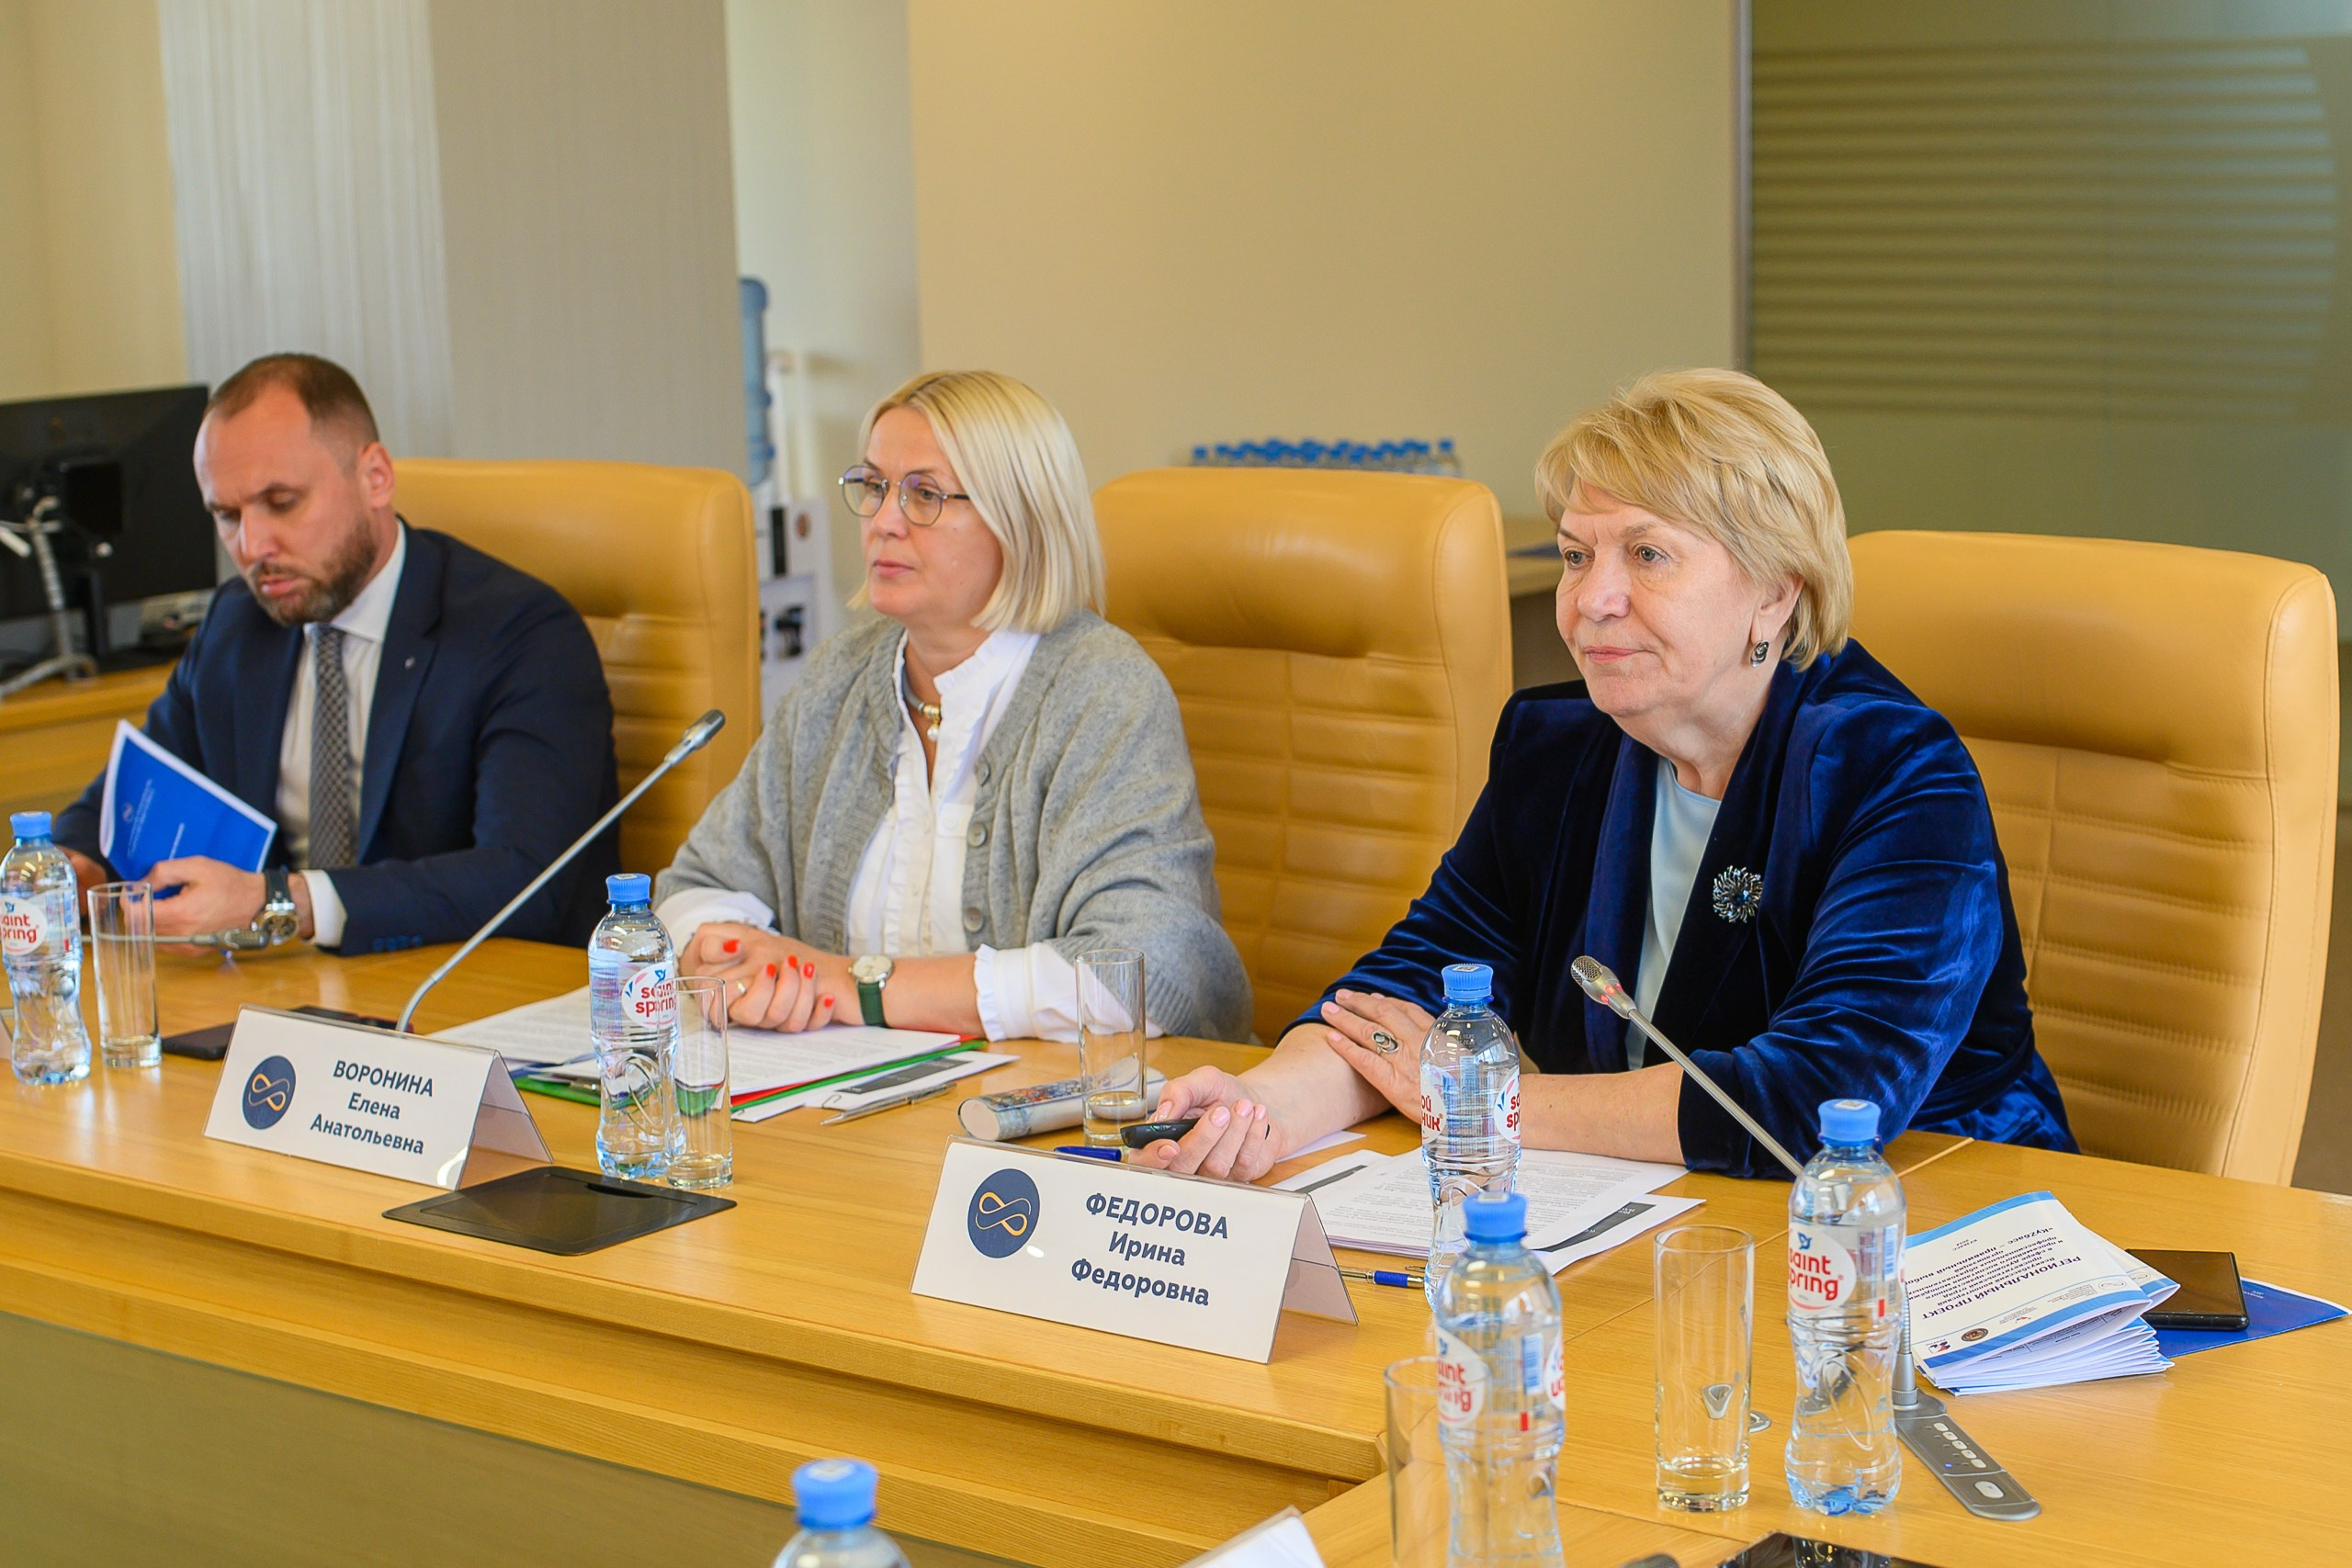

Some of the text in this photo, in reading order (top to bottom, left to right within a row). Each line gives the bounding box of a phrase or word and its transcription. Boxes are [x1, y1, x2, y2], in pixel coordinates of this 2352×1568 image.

[2, 913, 30, 927] aint
[3, 928, 38, 943] pring
[333, 1059, 434, 1097] ВОРОНИНА
[347, 1091, 401, 1120] Елена
[309, 1113, 424, 1155] Анатольевна
[1085, 1192, 1228, 1239] ФЕДОРОВА
[1108, 1231, 1186, 1267] Ирина
[1070, 1258, 1209, 1306] Федоровна
[1790, 1267, 1838, 1301] pring
[1973, 1256, 2081, 1300] РЕГИОНАЛЬНЫЙ
[1921, 1297, 1972, 1319] ПРОЕКТ
